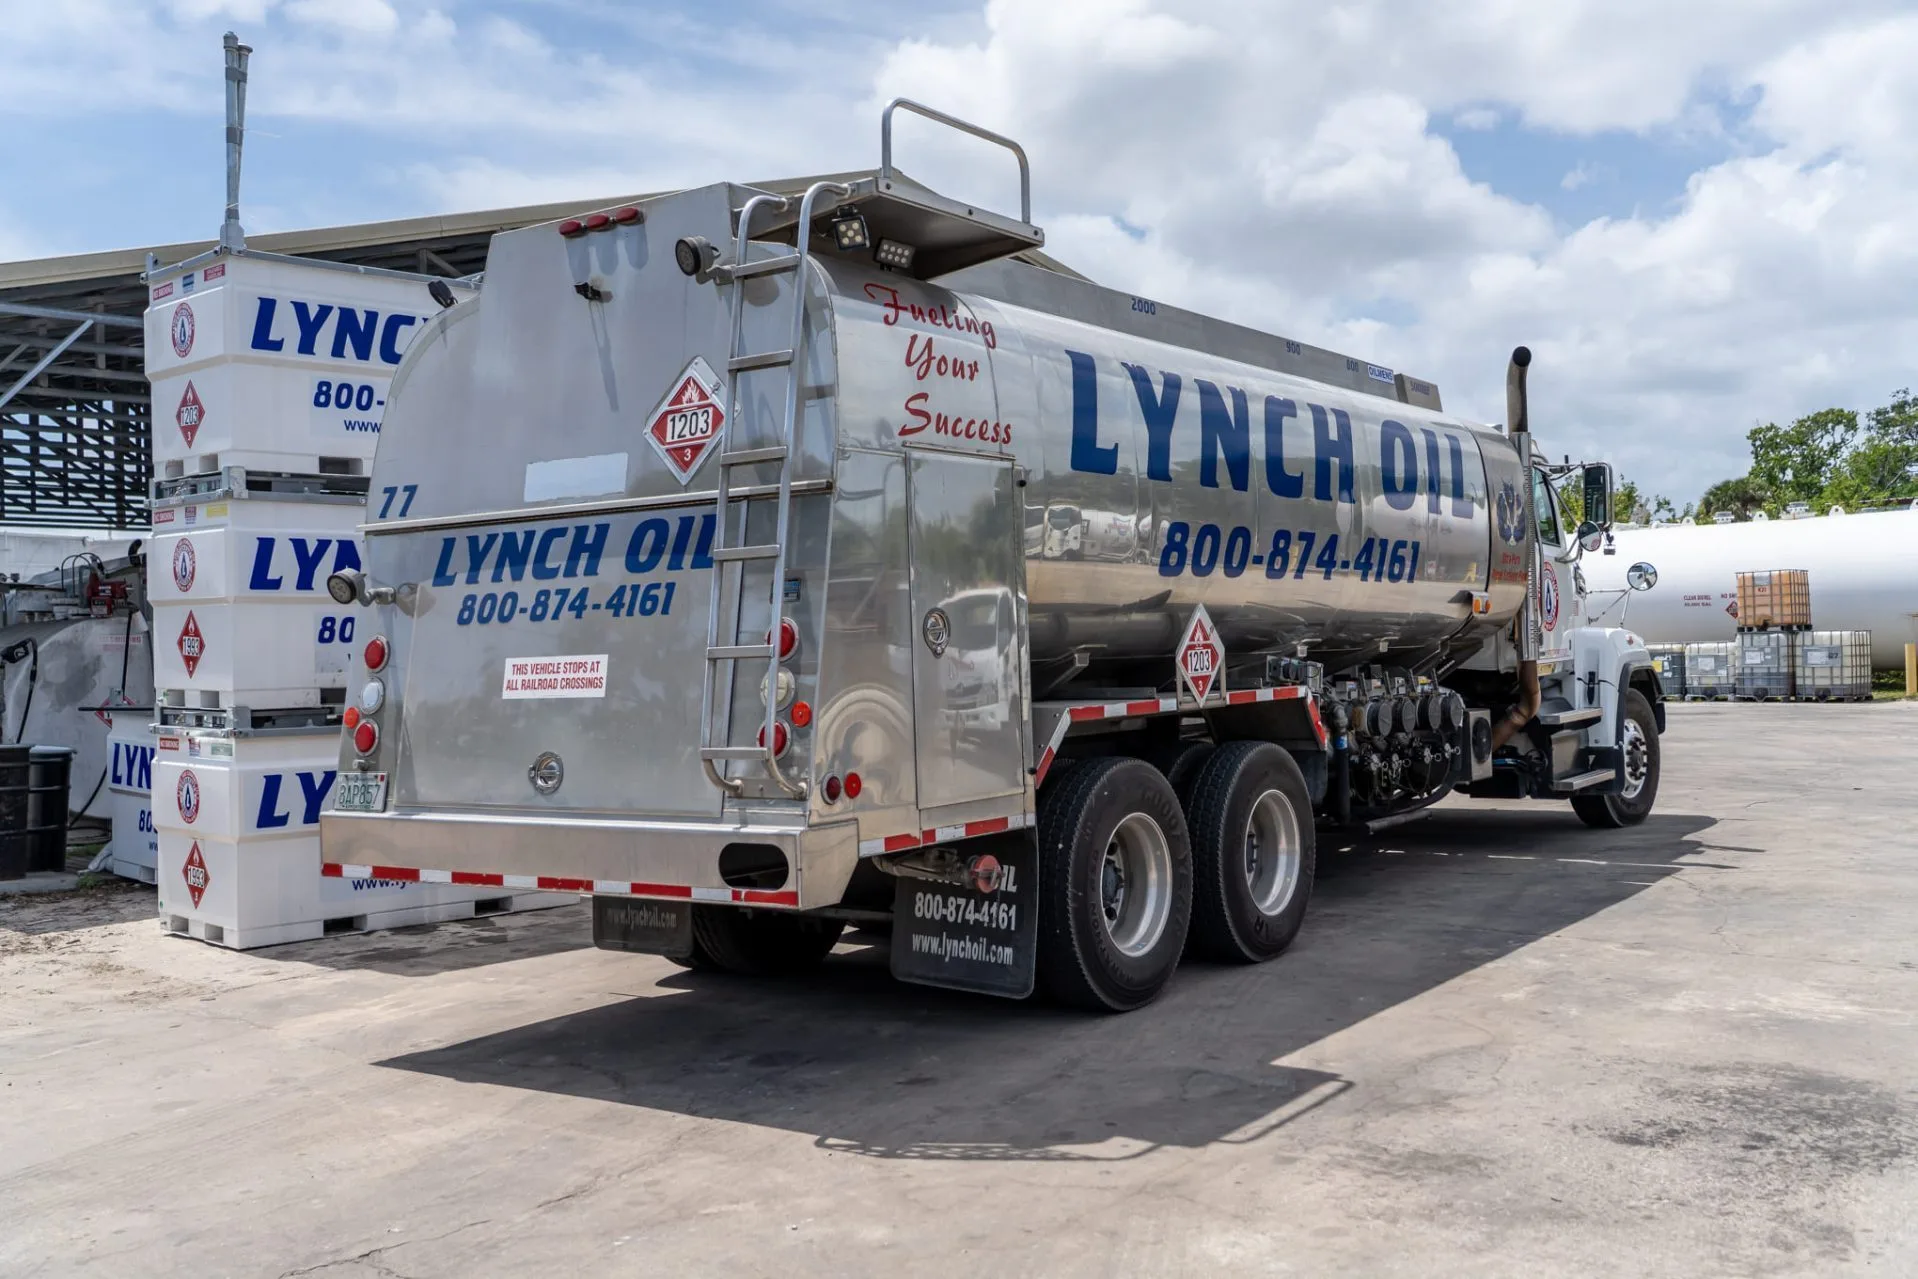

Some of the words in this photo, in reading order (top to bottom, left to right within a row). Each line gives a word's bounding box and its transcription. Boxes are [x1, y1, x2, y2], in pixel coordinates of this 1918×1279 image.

[864, 283, 996, 349] Fueling
[1131, 297, 1156, 316] 2000
[251, 297, 429, 365] LYNC
[904, 334, 979, 382] Your
[181, 406, 198, 425] 1203
[669, 409, 710, 440] 1203
[898, 392, 1013, 444] Success
[1065, 349, 1356, 505] LYNCH
[1380, 419, 1474, 519] OIL
[684, 449, 691, 461] 3
[379, 484, 418, 518] 77
[432, 523, 610, 587] LYNCH
[624, 513, 717, 573] OIL
[1159, 521, 1420, 583] 800-874-4161
[457, 582, 676, 626] 800-874-4161
[512, 664, 528, 675] THIS
[530, 663, 561, 674] VEHICLE
[563, 661, 588, 673] STOPS
[590, 661, 600, 673] AT
[1189, 650, 1209, 672] 1203
[506, 679, 519, 691] ALL
[521, 678, 558, 691] RAILROAD
[560, 677, 604, 689] CROSSINGS
[1198, 680, 1203, 691] 3
[138, 809, 158, 834] 80
[914, 892, 1017, 931] 800-874-4161
[912, 931, 1013, 965] www.lynchoil.com
